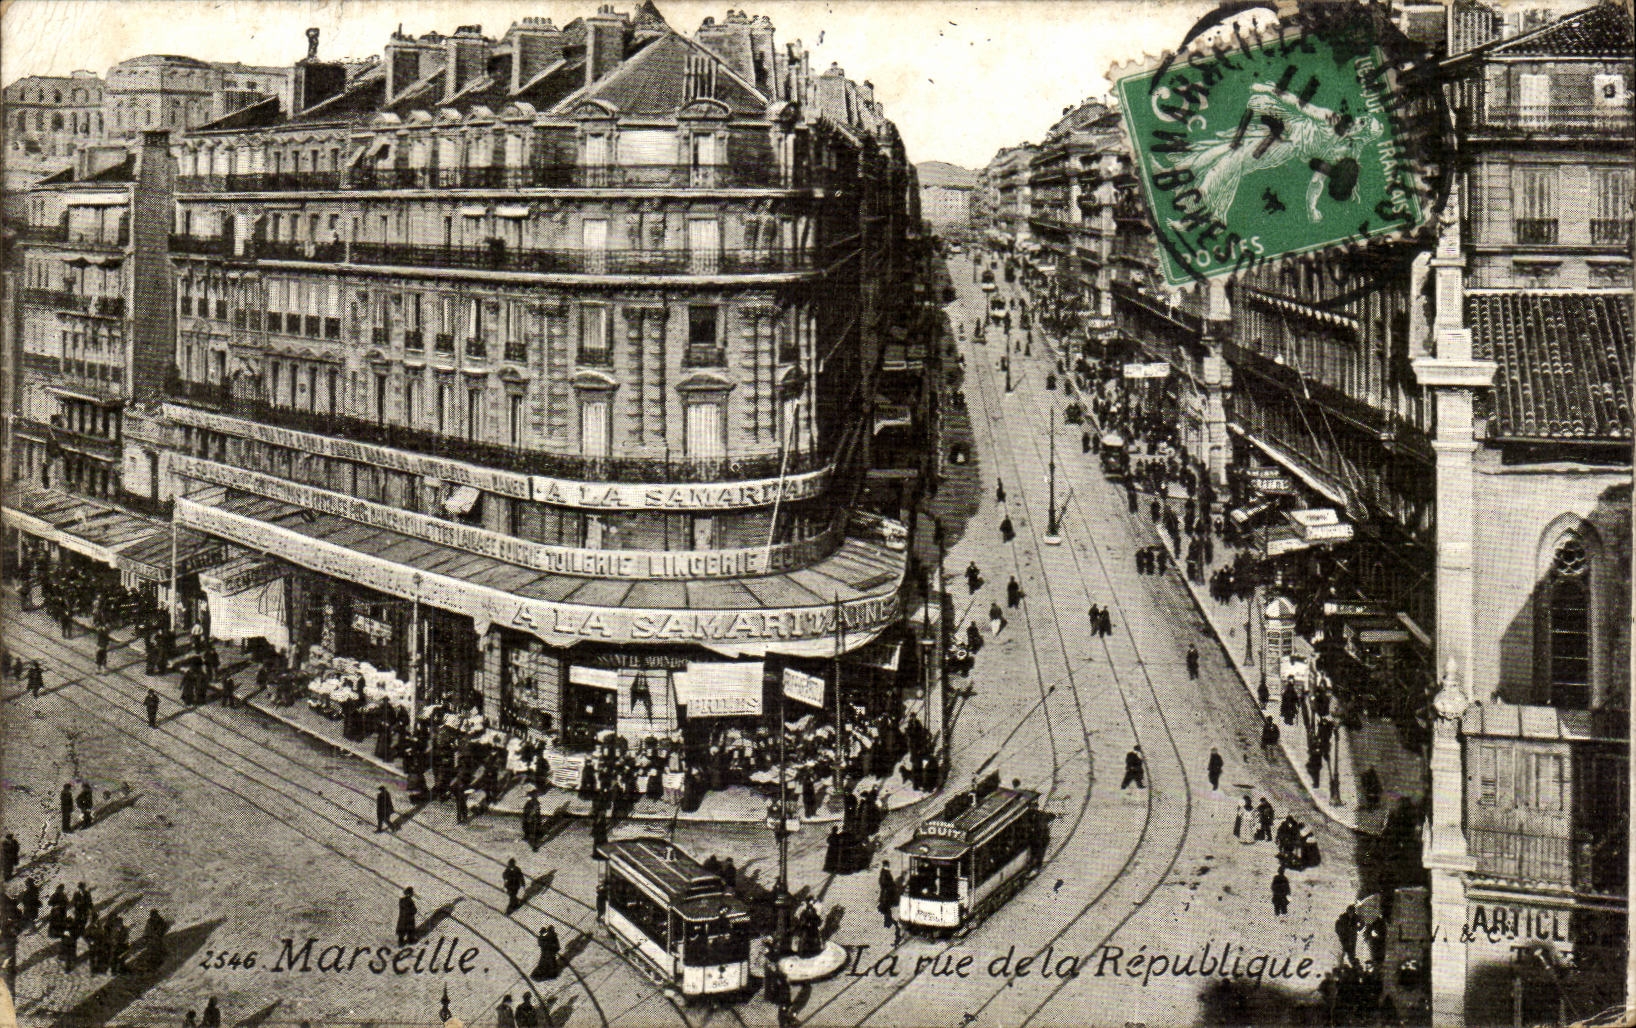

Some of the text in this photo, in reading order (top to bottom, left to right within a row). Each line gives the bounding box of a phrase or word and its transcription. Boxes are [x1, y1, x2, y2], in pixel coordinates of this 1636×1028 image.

[545, 482, 567, 503] A
[578, 485, 630, 507] LA
[648, 551, 758, 578] LINGERIE
[511, 602, 539, 629] A
[552, 608, 612, 638] LA
